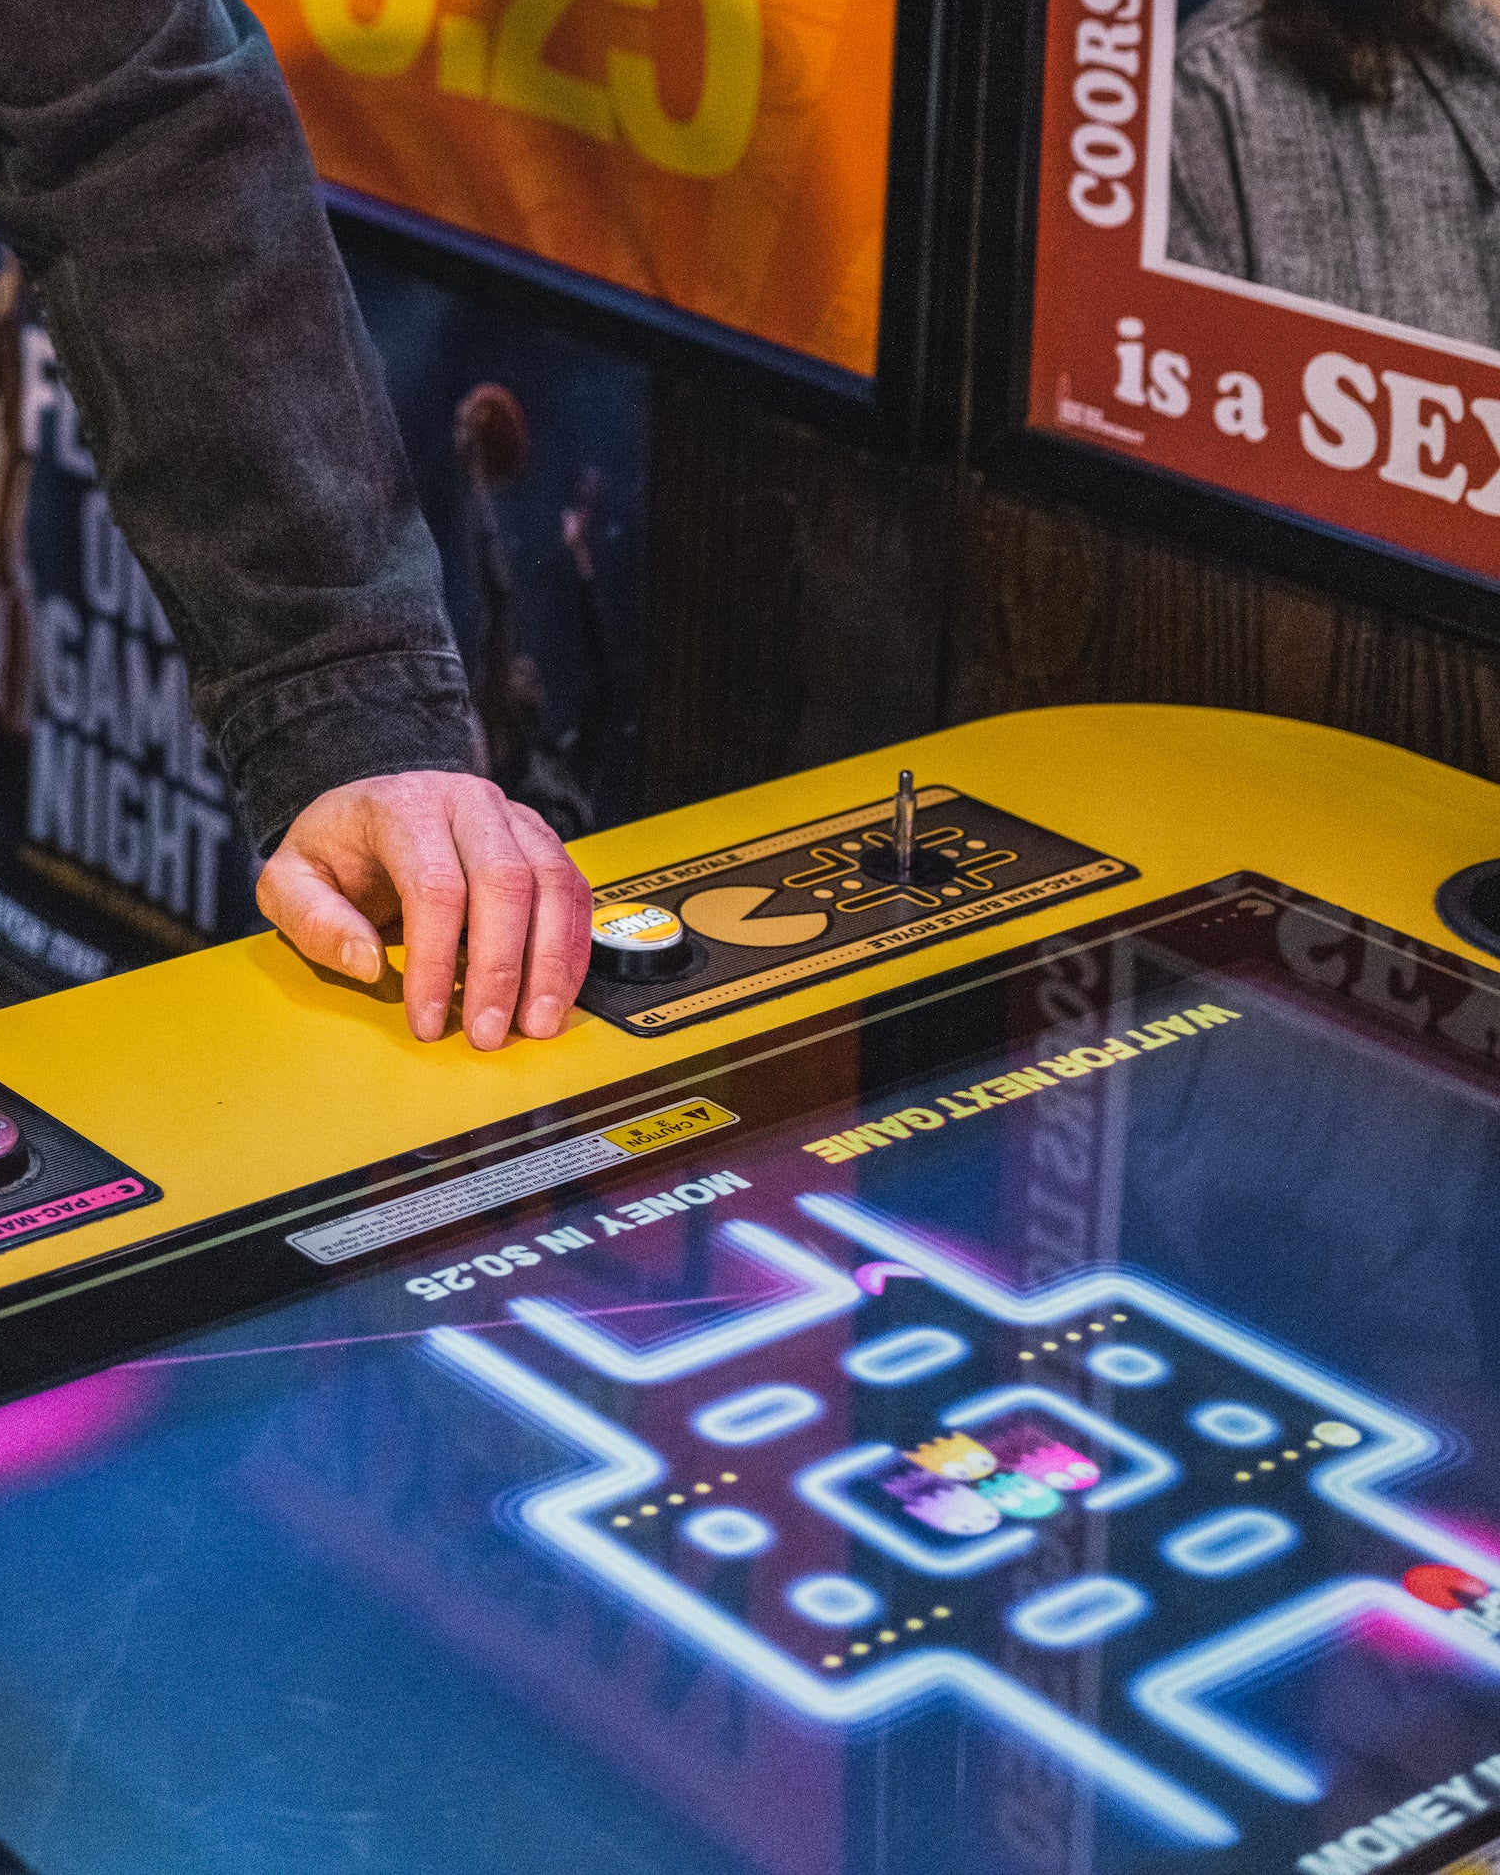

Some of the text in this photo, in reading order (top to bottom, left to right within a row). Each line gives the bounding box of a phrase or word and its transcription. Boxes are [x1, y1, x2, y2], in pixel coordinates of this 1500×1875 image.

[1114, 316, 1191, 419] is
[1213, 370, 1269, 443] a
[29, 719, 234, 932] NIGHT
[604, 853, 744, 901] BATTLE ROYALE
[600, 907, 674, 938] START
[866, 875, 1083, 950] PAC-MAN BATTLE ROYALE
[641, 1011, 668, 1026] 1P
[802, 1003, 1242, 1164] WAIT FOR NEXT GAME
[624, 1119, 696, 1147] CAUTION
[594, 1170, 752, 1236] MONEY
[534, 1226, 596, 1255] IN
[1297, 1775, 1490, 1875] MONEY
